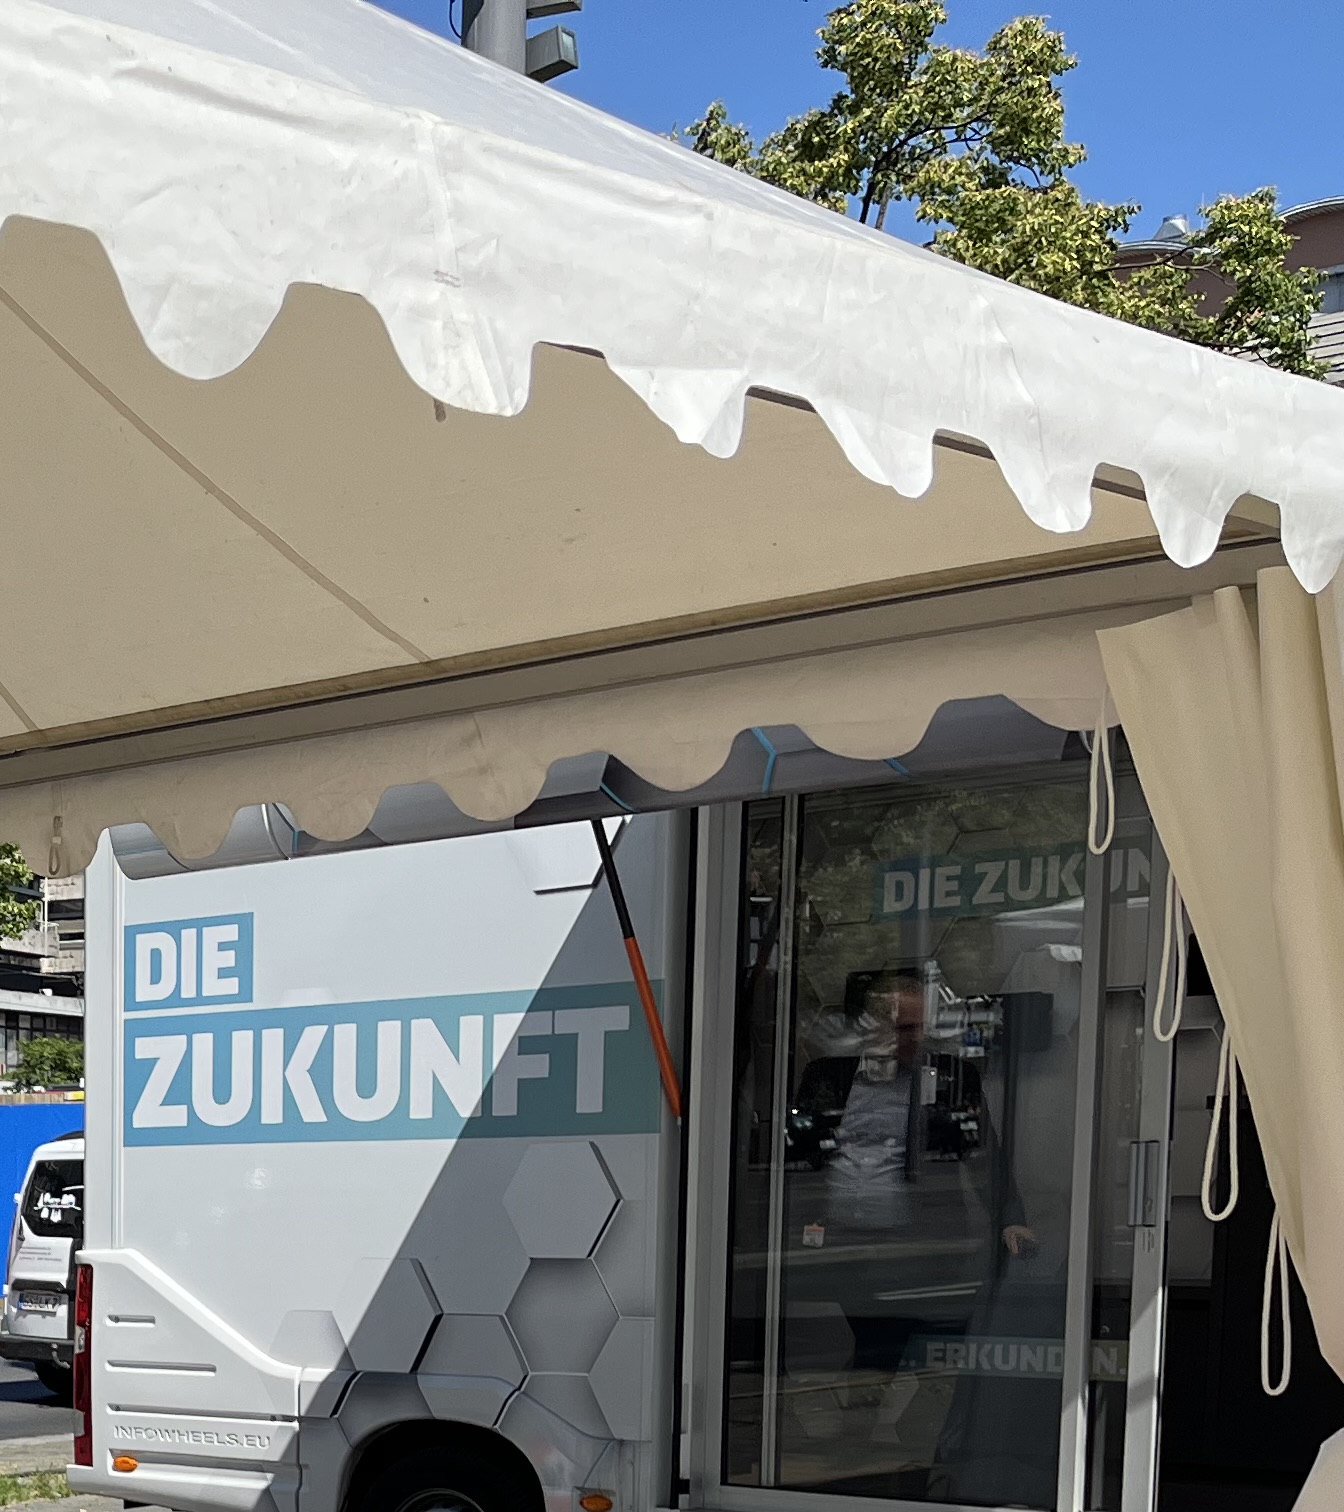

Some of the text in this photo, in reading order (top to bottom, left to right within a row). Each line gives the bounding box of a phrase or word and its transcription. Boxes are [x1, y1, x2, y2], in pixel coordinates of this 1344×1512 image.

[883, 865, 963, 914] DIE
[133, 922, 242, 1001] DIE
[131, 1004, 630, 1130] ZUKUNFT
[925, 1341, 1127, 1376] ERKUNDN.
[113, 1425, 270, 1450] INFOWHEELS.EU
